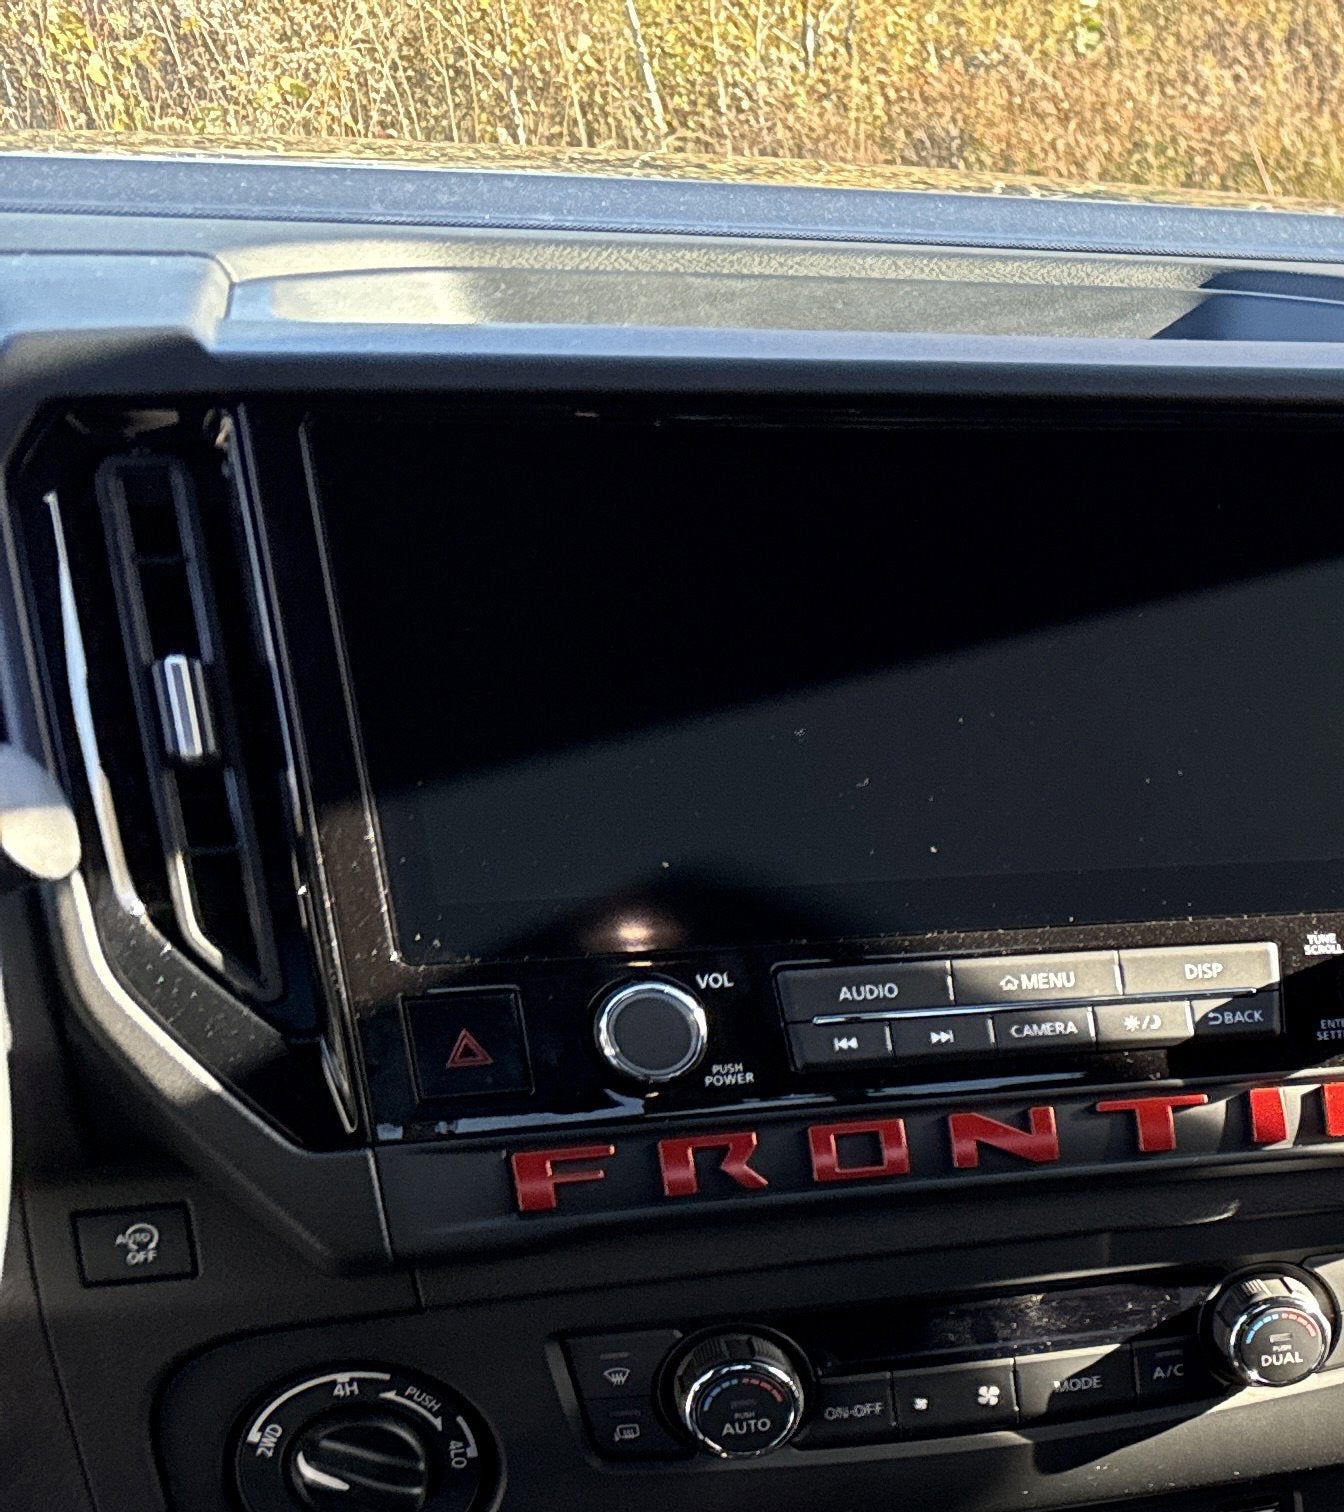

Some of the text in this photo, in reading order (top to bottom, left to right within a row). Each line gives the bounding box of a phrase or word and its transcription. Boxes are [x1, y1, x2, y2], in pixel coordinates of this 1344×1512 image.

[1306, 931, 1338, 945] TUNE
[1304, 943, 1344, 956] SCROLL
[1183, 961, 1224, 981] DISP
[695, 972, 734, 989] VOL
[1020, 970, 1076, 992] MENU
[837, 981, 899, 1001] AUDIO
[1222, 1007, 1265, 1026] BACK
[1010, 1018, 1079, 1039] CAMERA
[711, 1062, 744, 1075] PUSH
[703, 1070, 755, 1088] POWER
[126, 1248, 158, 1266] OFF
[1272, 1345, 1292, 1354] PUSH
[1260, 1352, 1304, 1368] DUAL
[1153, 1363, 1186, 1380] A/C
[333, 1382, 360, 1398] 4H
[1054, 1375, 1104, 1393] MODE
[403, 1384, 442, 1414] PUSH
[734, 1411, 756, 1420] PUSH
[824, 1402, 885, 1421] ON-OFF
[721, 1418, 772, 1437] AUTO
[255, 1422, 284, 1459] 2WD
[448, 1439, 468, 1470] 4LO
